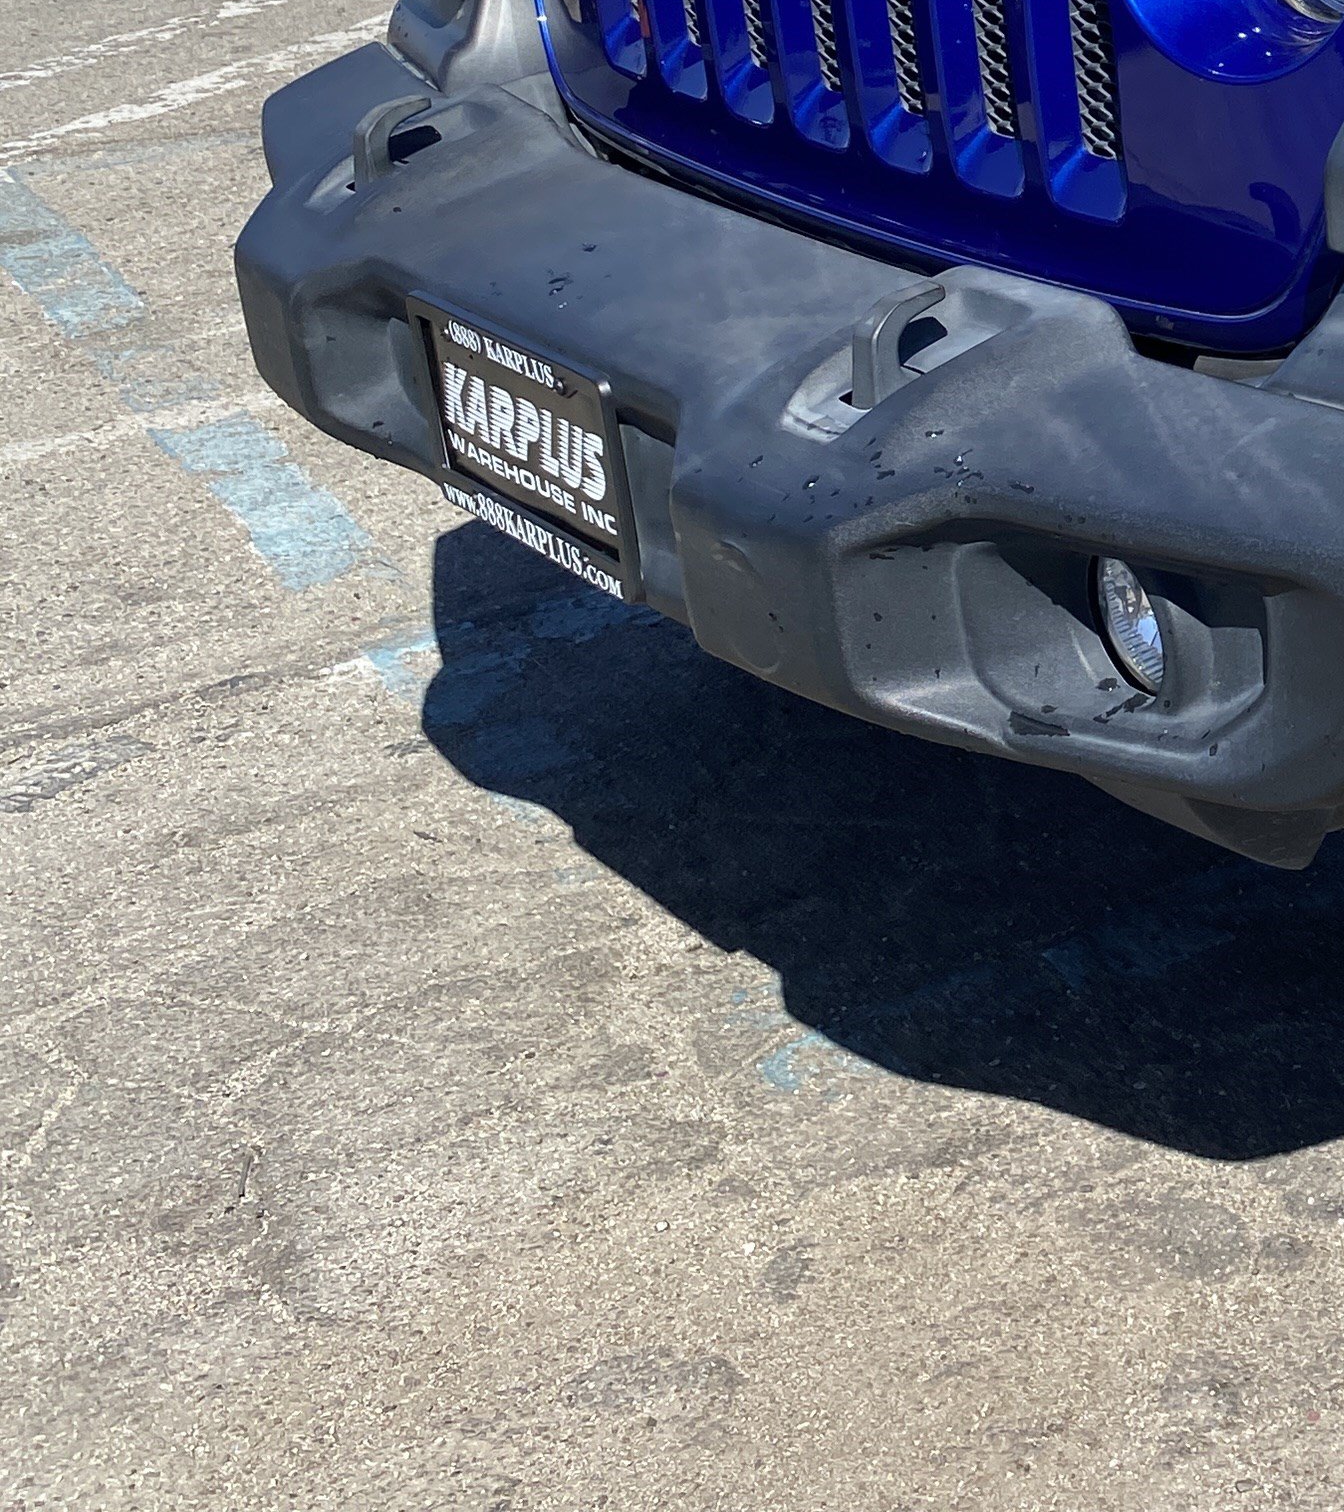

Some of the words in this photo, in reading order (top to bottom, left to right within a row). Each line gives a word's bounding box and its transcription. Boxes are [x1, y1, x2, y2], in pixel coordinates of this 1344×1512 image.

[447, 319, 481, 356] (888)
[483, 336, 554, 389] KARPLUS
[444, 361, 607, 501] KARPLUS
[447, 428, 577, 514] WAREHOUSE
[581, 501, 618, 536] INC
